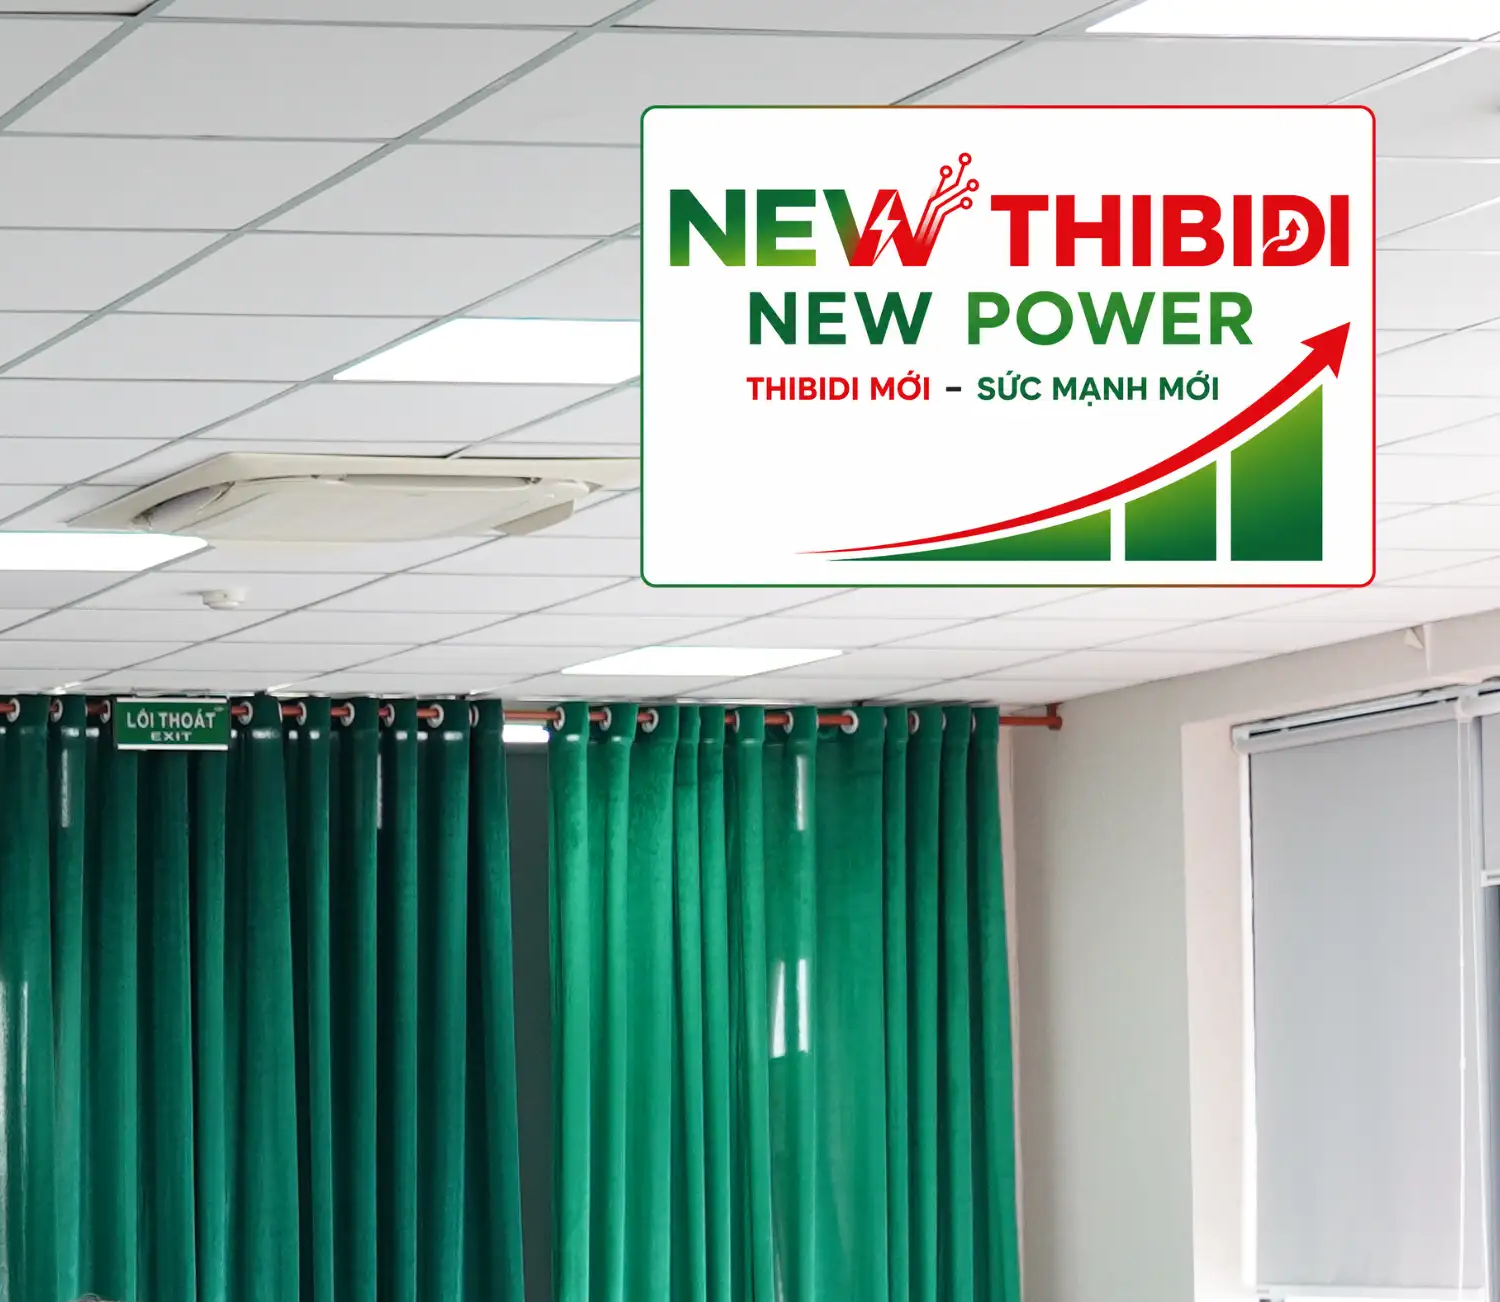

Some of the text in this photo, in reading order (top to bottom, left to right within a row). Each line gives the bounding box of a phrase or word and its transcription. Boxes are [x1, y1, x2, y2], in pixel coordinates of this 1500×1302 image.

[126, 708, 217, 729] LỐI THOÁT
[150, 731, 193, 742] EXIT
